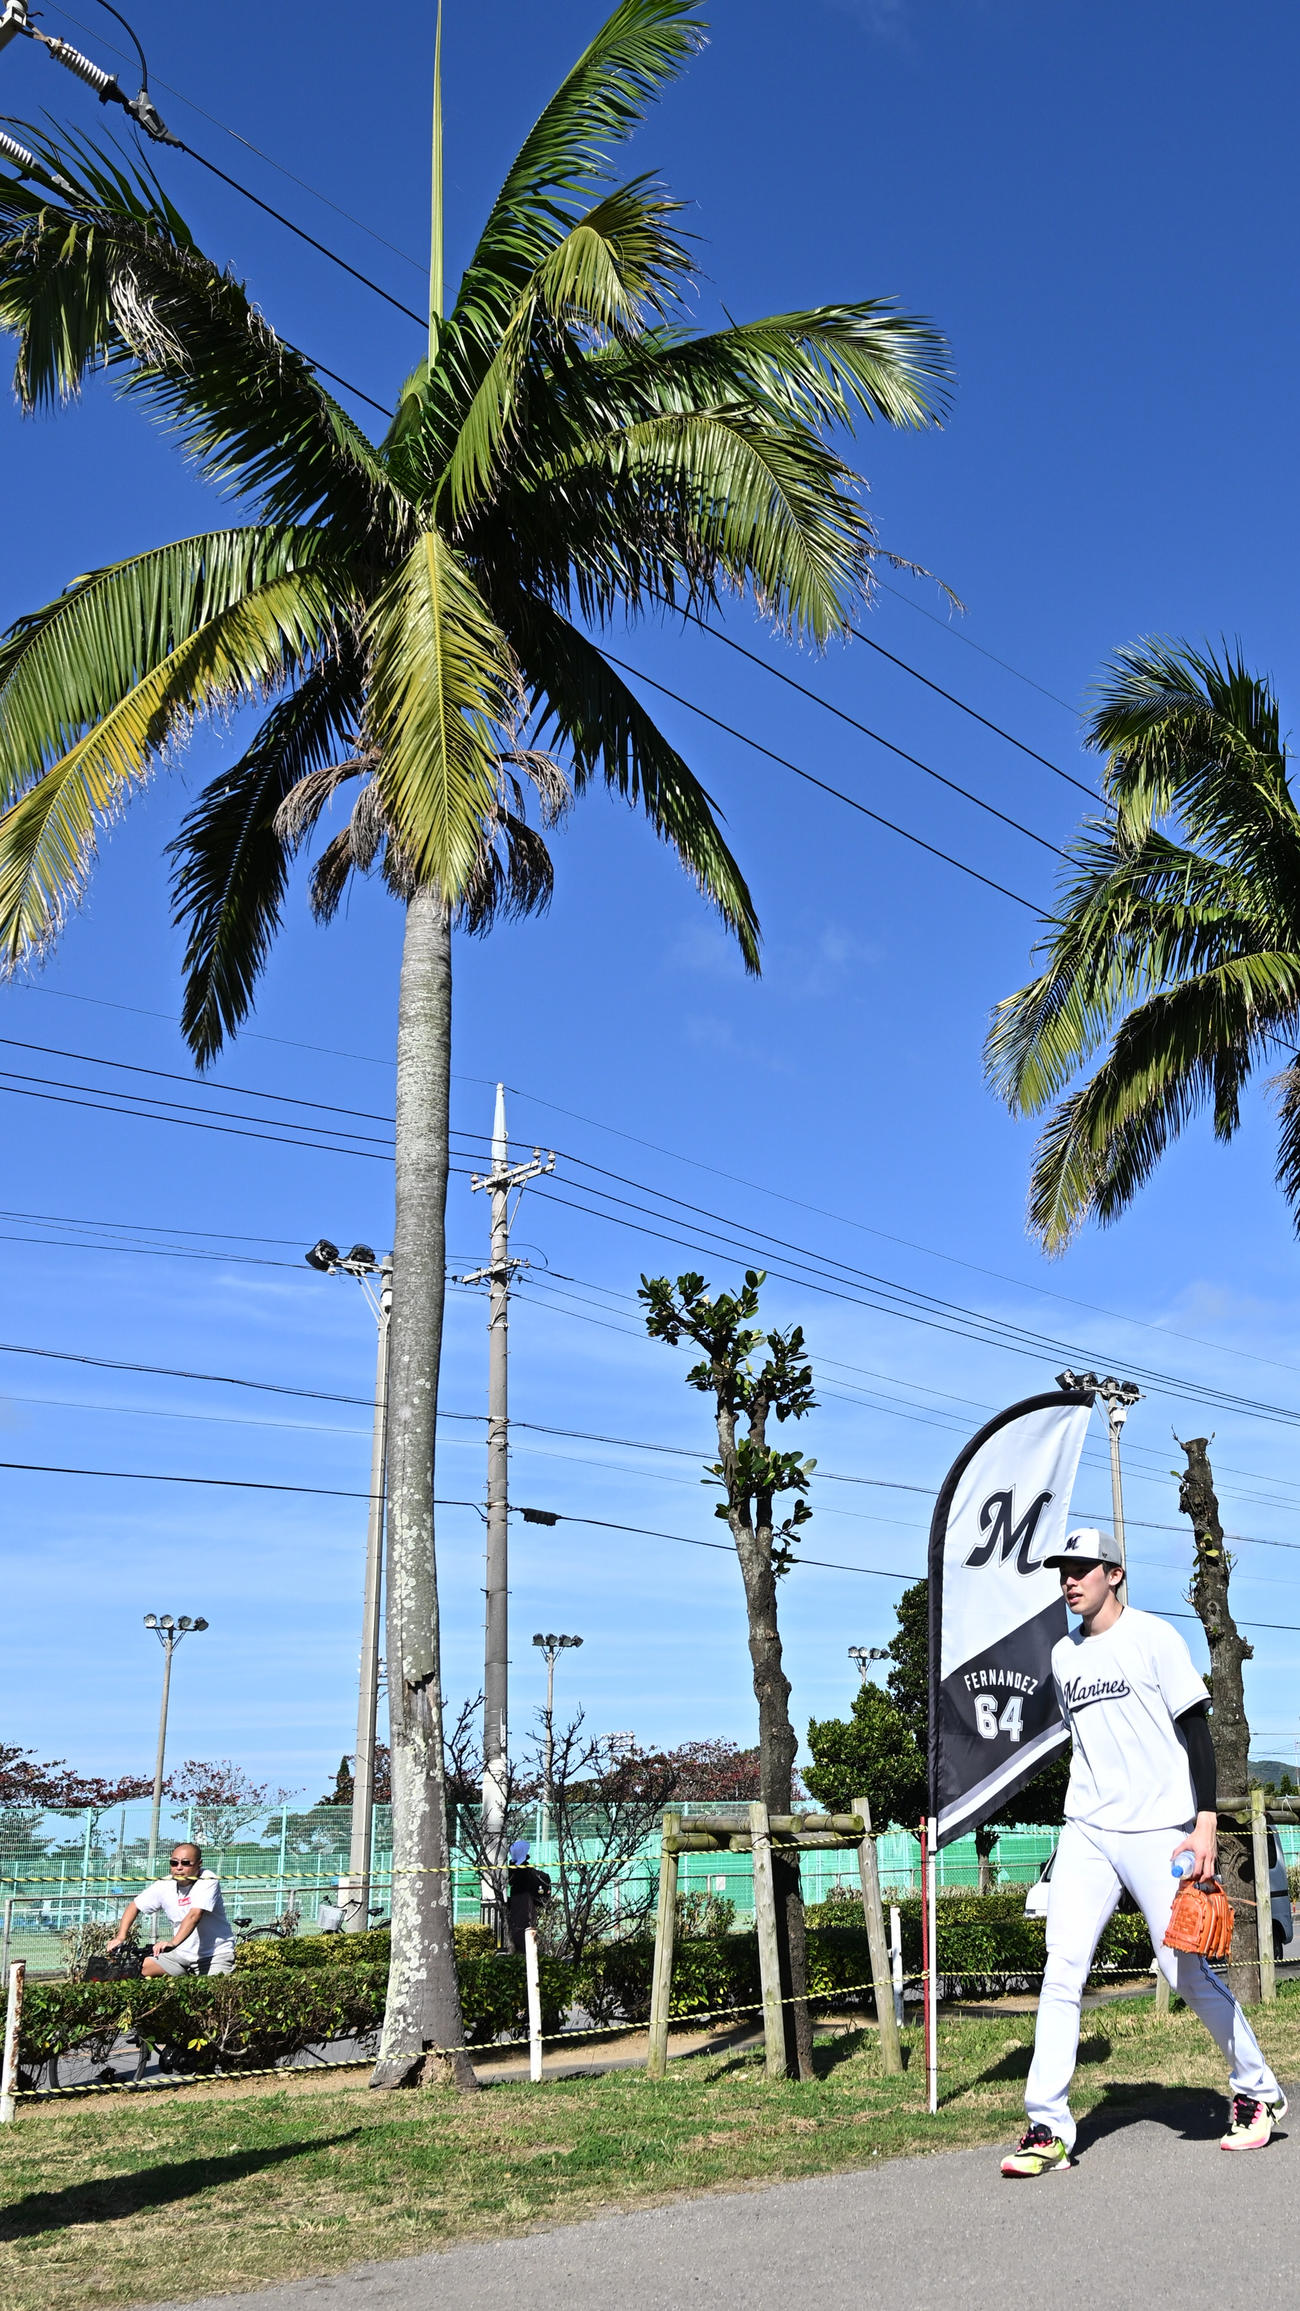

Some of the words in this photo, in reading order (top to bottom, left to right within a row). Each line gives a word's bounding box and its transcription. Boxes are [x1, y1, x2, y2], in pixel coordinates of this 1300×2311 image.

[962, 1484, 1055, 1577] M
[1064, 1535, 1081, 1552] M
[963, 1669, 1038, 1695] FERNANDEZ
[1064, 1676, 1129, 1709] Marines
[974, 1693, 1023, 1741] 64
